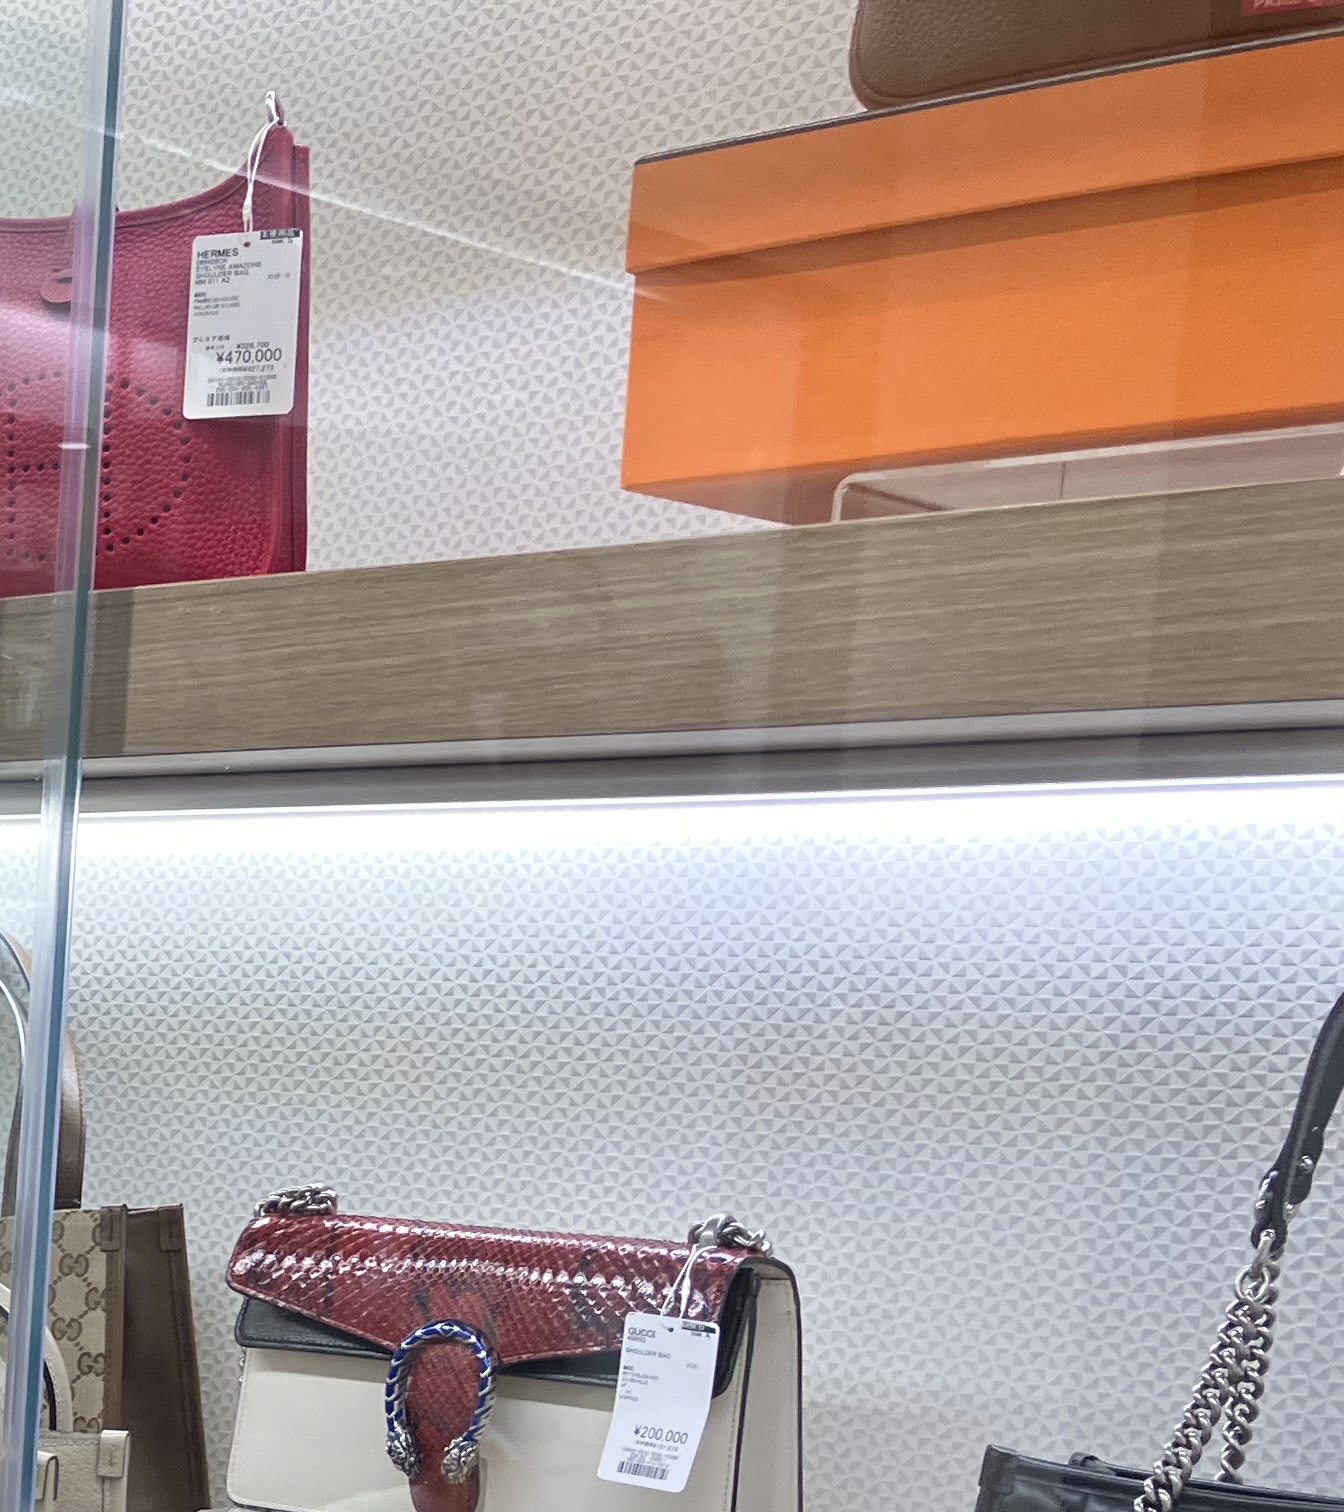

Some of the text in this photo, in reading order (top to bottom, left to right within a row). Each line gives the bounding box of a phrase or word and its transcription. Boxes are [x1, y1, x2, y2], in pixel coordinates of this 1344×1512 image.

[196, 248, 239, 259] HERMES
[216, 348, 282, 364] ¥470,000
[628, 1327, 656, 1339] GUCCI
[634, 1424, 688, 1445] ¥200,000
